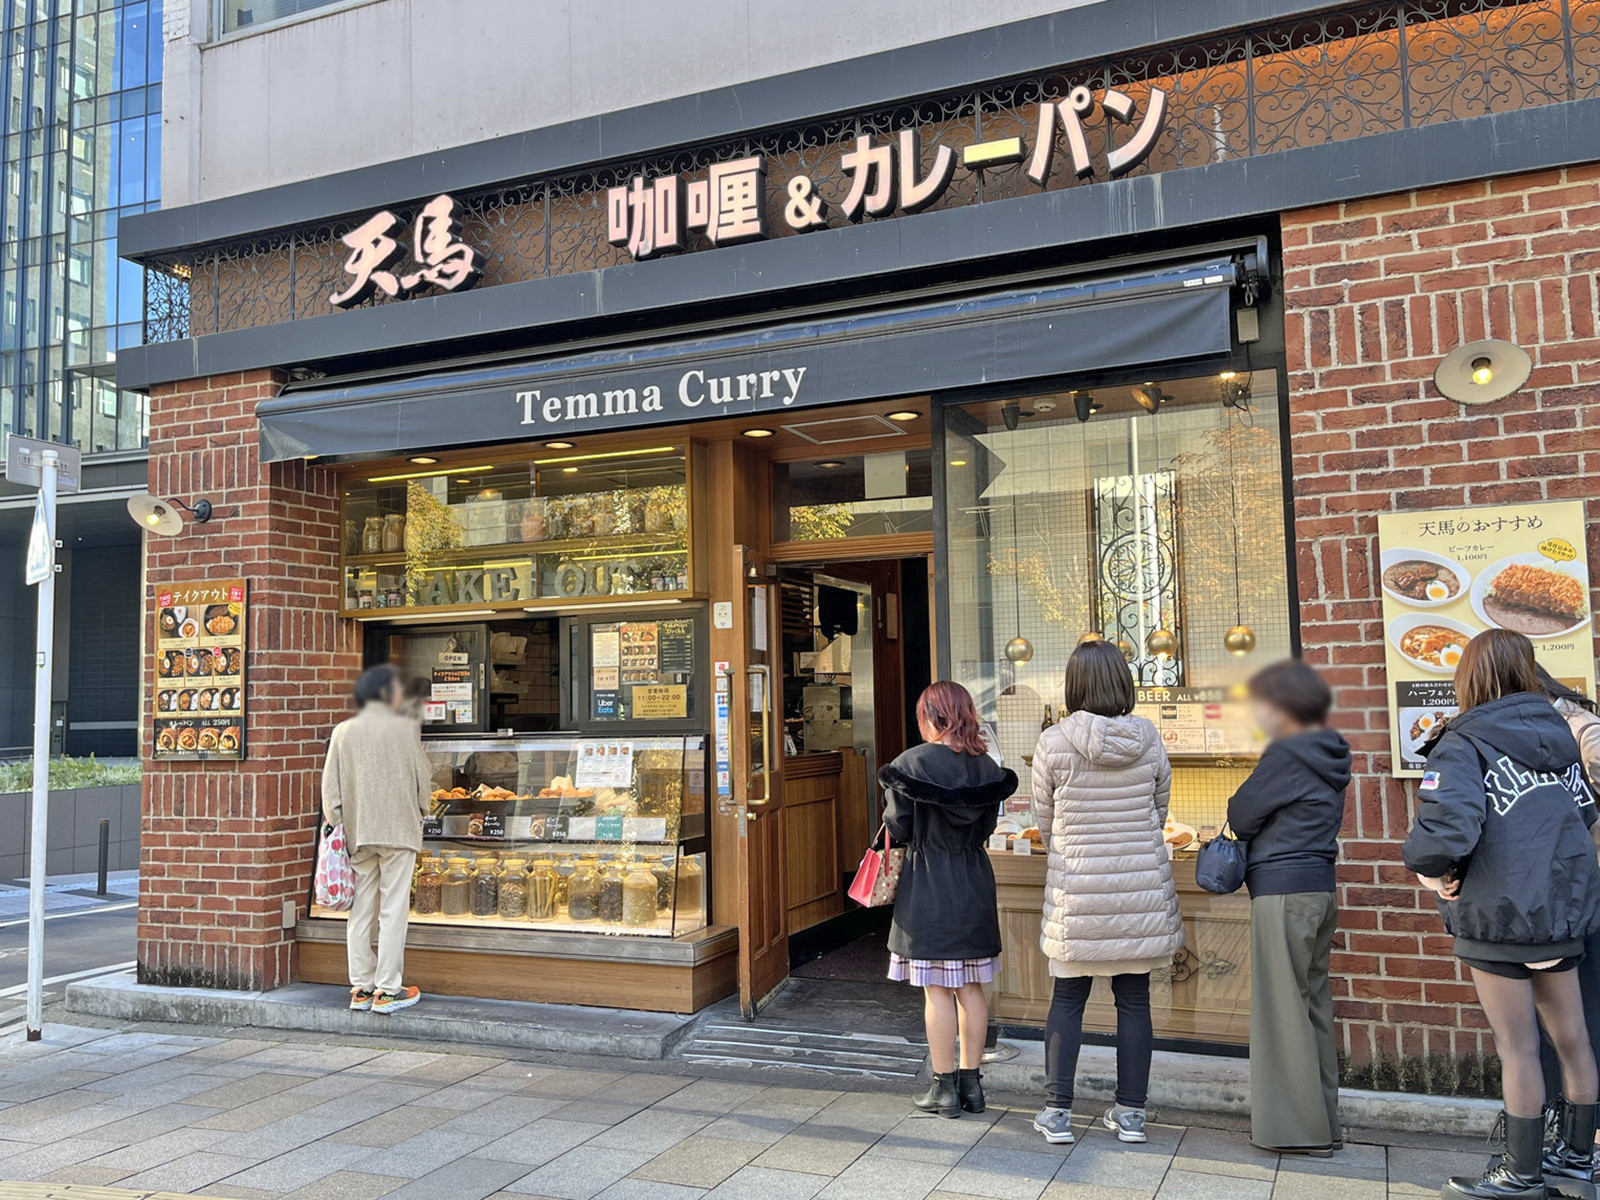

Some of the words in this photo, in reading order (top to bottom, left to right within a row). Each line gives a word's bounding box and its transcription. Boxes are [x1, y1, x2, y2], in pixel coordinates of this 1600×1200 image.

[330, 193, 478, 306] 天馬
[607, 156, 767, 257] 咖喱
[785, 175, 824, 229] &
[840, 87, 1167, 218] カレーパン
[516, 390, 663, 425] Temma
[678, 366, 807, 405] Curry
[1418, 515, 1543, 537] 天馬のおすすめ
[1448, 544, 1495, 553] ビーフカレー
[1457, 553, 1487, 561] 1,100円
[402, 566, 520, 606] AKE
[173, 587, 228, 603] テイクアウト
[1542, 643, 1574, 651] 1,200円
[1138, 690, 1171, 702] BEER
[1408, 689, 1457, 697] ハーフ&ハ
[490, 828, 504, 836] ¥250
